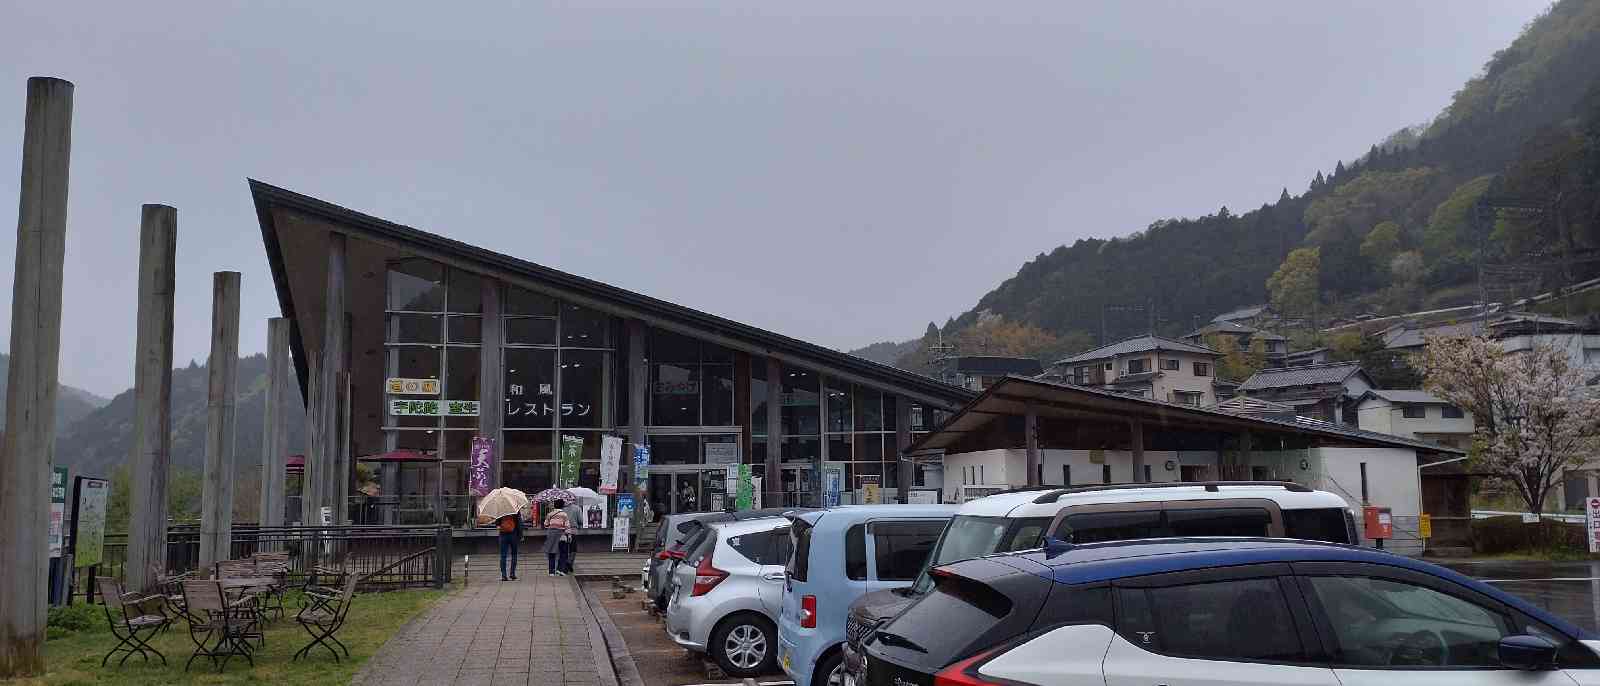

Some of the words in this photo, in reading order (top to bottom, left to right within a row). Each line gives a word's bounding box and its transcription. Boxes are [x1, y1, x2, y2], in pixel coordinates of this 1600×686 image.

[508, 402, 590, 416] レストラン
